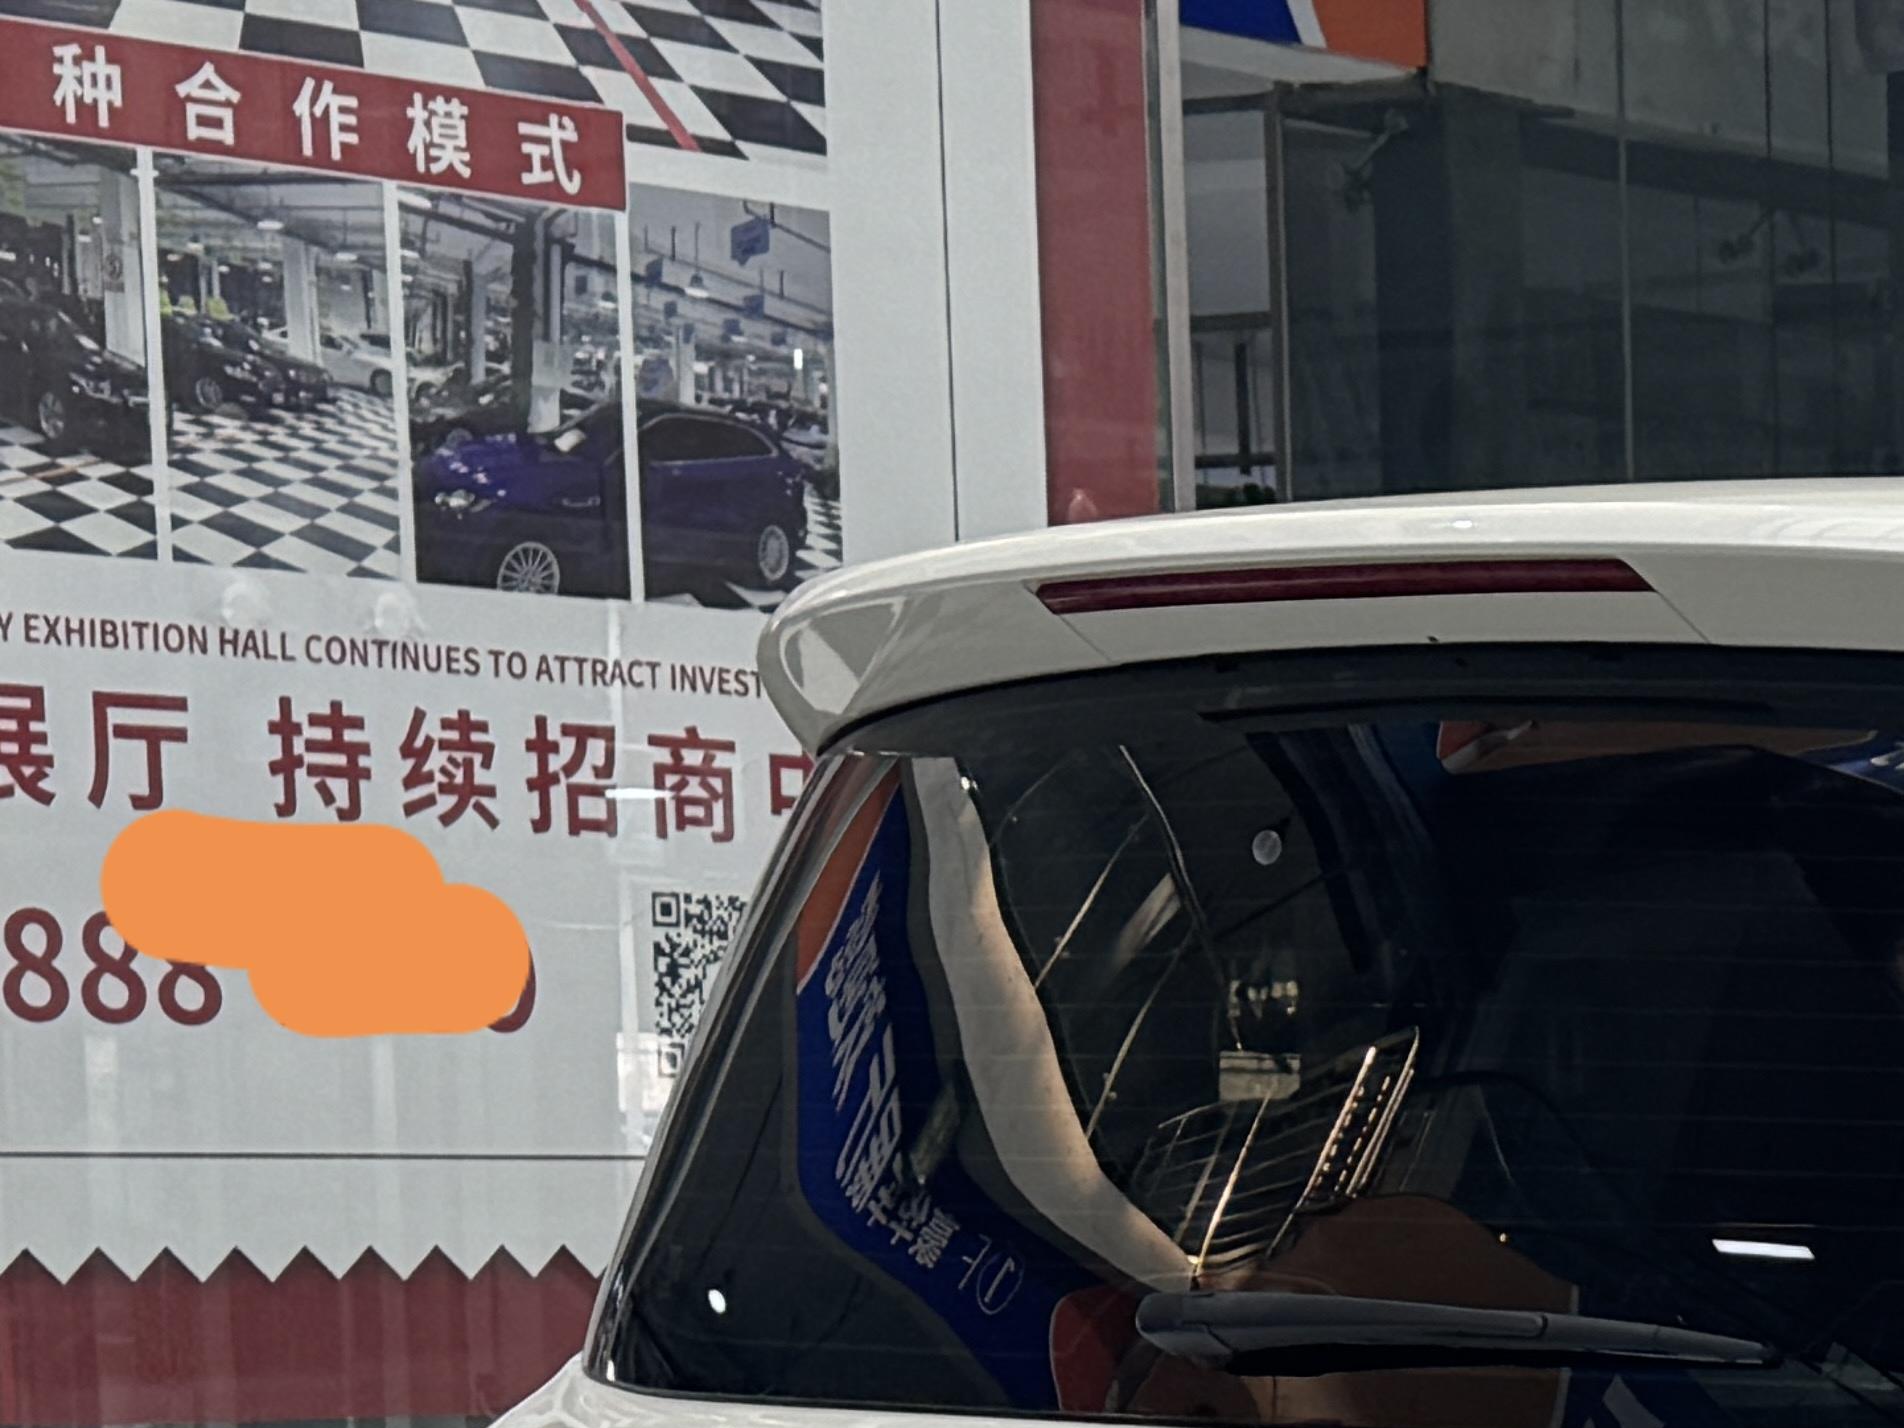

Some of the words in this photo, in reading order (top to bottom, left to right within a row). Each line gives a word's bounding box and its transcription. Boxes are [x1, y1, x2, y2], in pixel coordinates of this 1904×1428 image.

[52, 41, 583, 197] 种合作模式
[23, 612, 209, 656] EXHIBITION
[218, 626, 298, 662] HALL
[304, 633, 482, 678] CONTINUES
[487, 649, 528, 680] TO
[535, 654, 661, 690] ATTRACT
